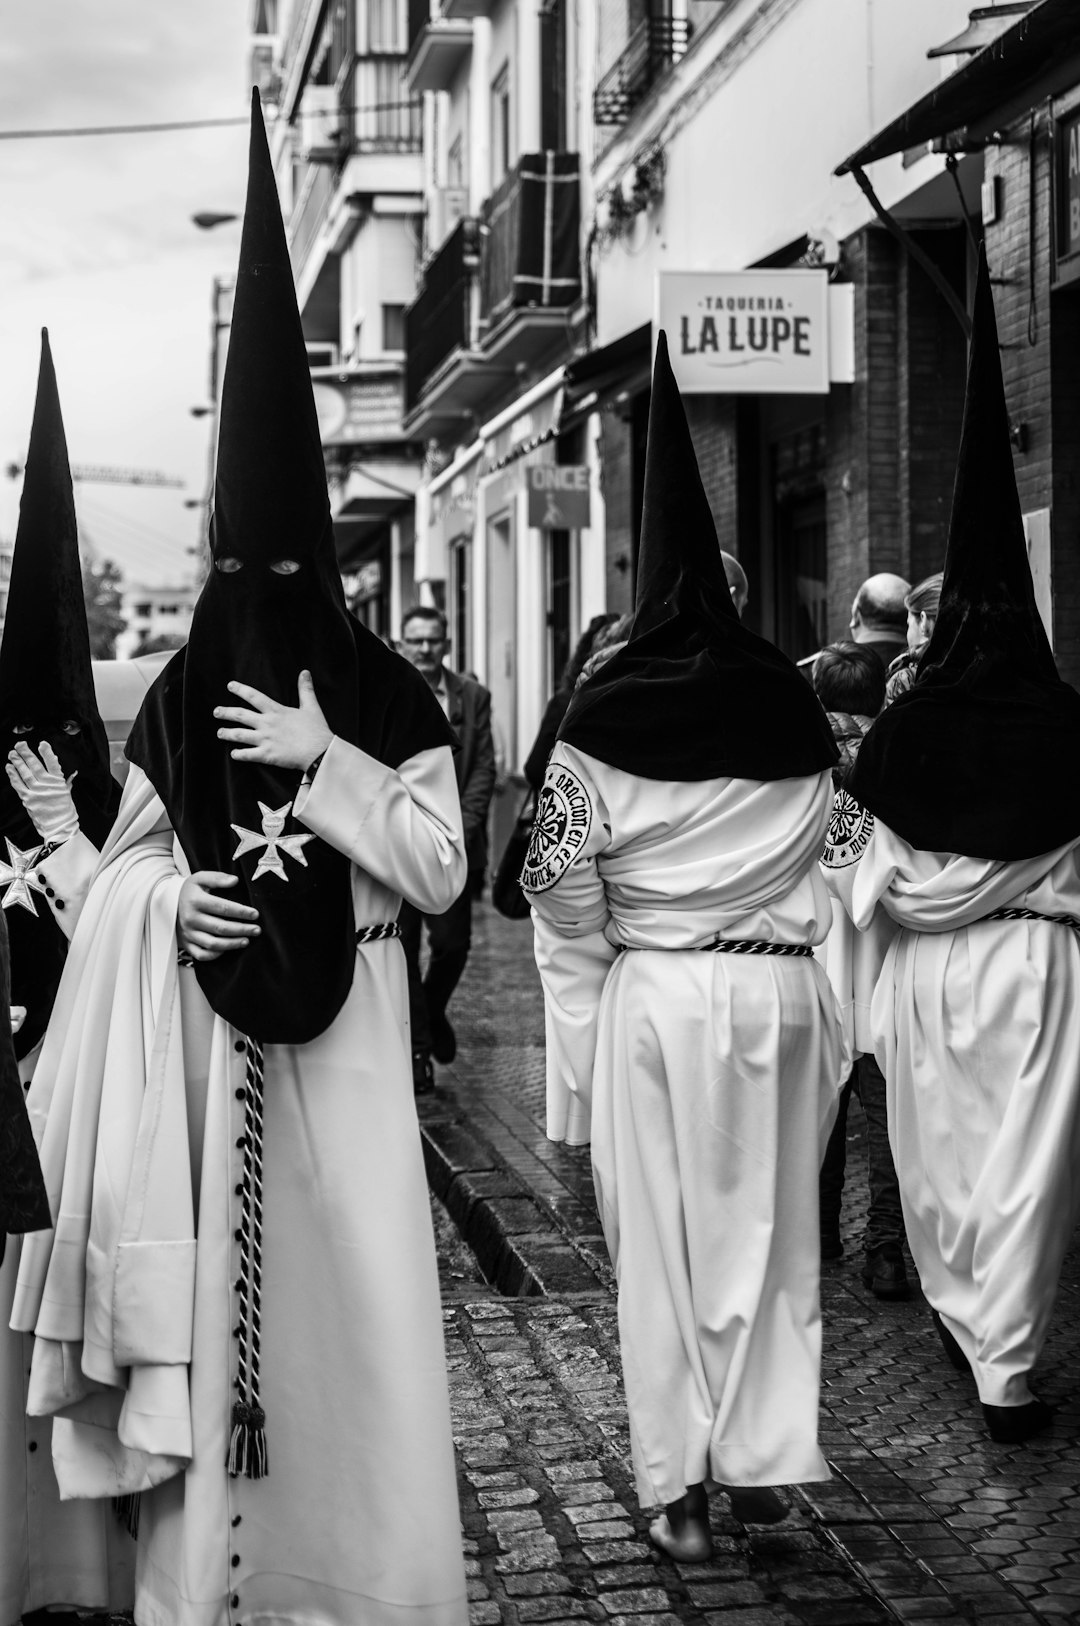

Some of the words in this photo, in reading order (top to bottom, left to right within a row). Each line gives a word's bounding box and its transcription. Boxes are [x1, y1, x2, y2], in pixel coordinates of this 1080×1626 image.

[705, 296, 785, 311] TAQUERIA
[680, 315, 719, 356] LA
[729, 315, 811, 356] LUPE
[533, 466, 589, 490] ONCE
